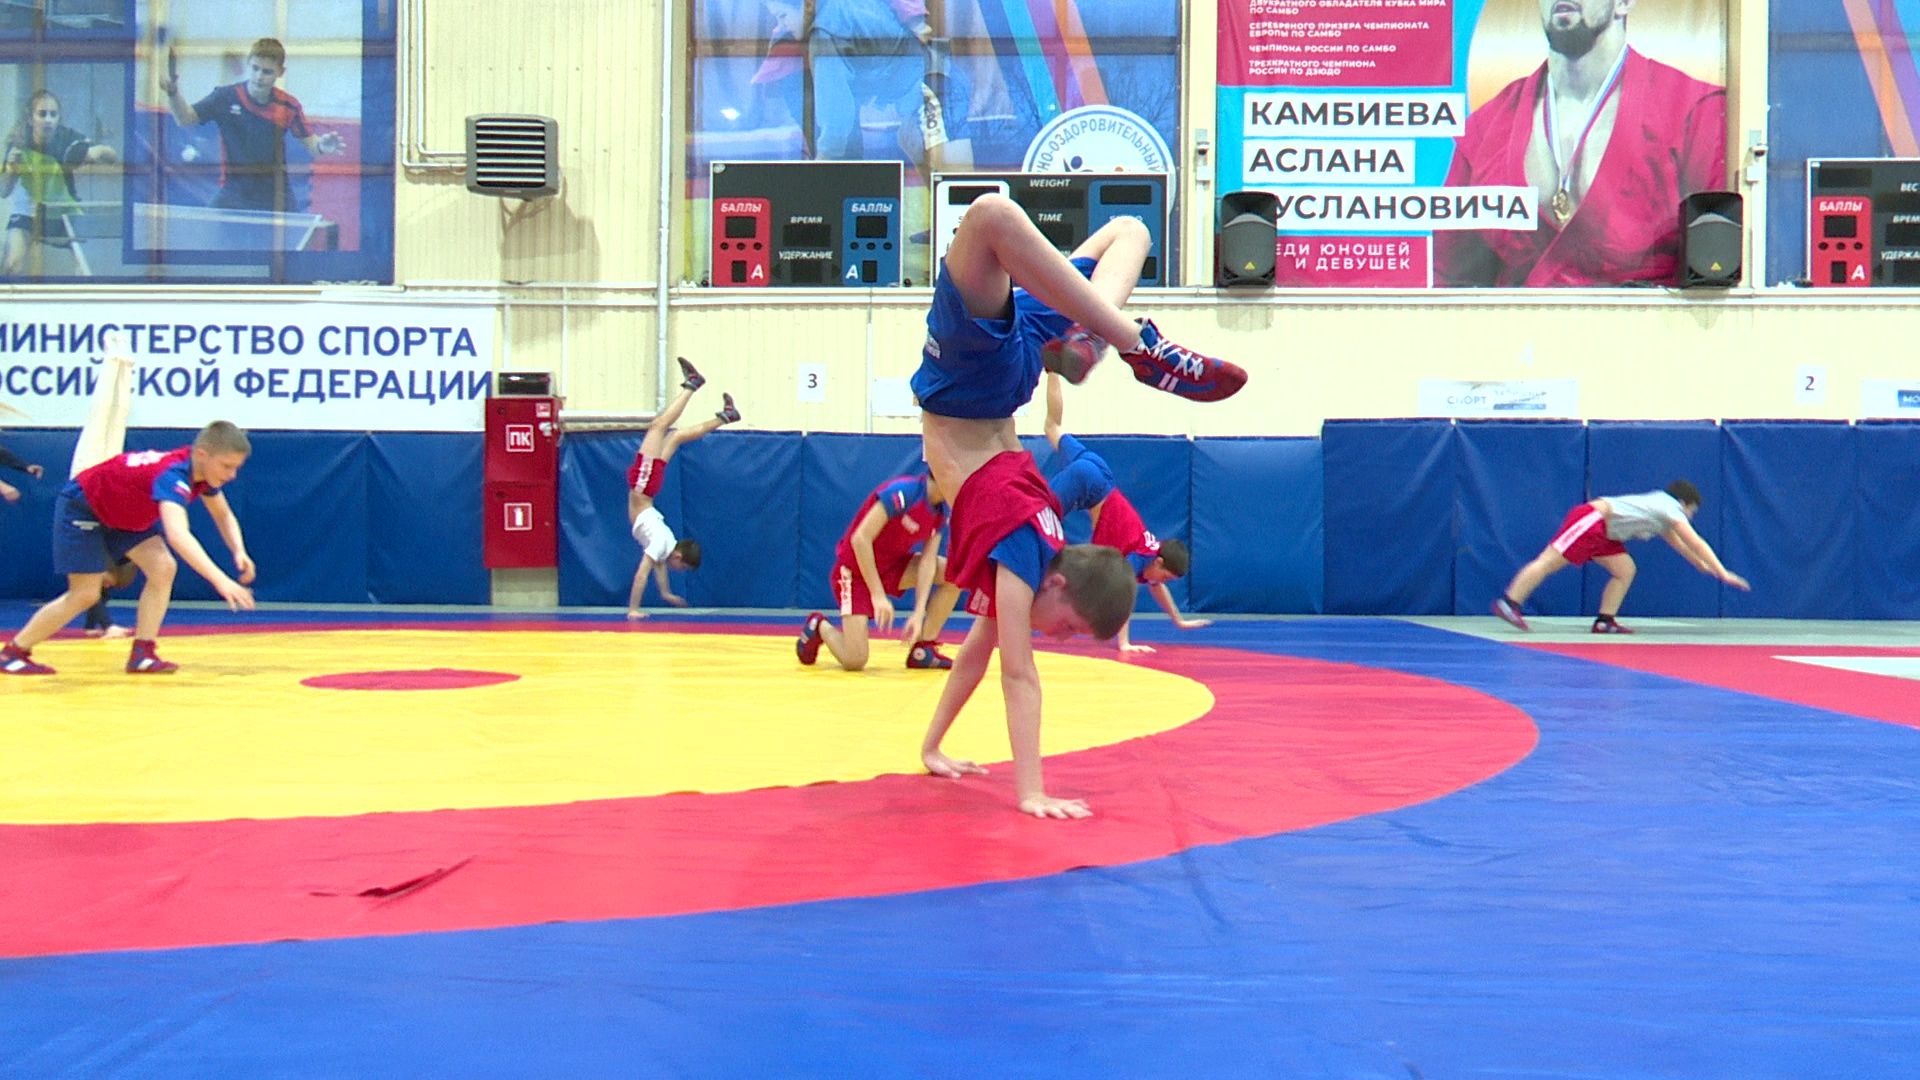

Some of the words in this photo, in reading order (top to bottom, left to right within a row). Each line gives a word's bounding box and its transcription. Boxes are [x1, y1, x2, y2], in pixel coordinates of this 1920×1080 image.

[1266, 7, 1299, 15] САМБО
[1249, 22, 1316, 30] СЕРЕБРЯНОГО
[1318, 22, 1361, 30] ПРИЗЕРА
[1364, 22, 1430, 30] ЧЕМПИОНАТА
[1249, 44, 1302, 52] ЧЕМПИОНА
[1304, 45, 1343, 53] РОССИИ
[1346, 45, 1360, 53] ПО
[1322, 60, 1376, 68] ЧЕМПИОНА
[1249, 67, 1288, 75] РОССИИ
[1305, 68, 1341, 76] ДЗЮДО
[1250, 101, 1457, 126] КАМБИЕВА
[1249, 148, 1405, 173] АСЛАНА
[1029, 178, 1071, 187] WEIGHT
[1900, 182, 1918, 192] ВЕС
[720, 203, 762, 213] БАЛЛЫ
[851, 203, 893, 213] БАЛЛЫ
[1276, 195, 1530, 220] УСЛАНОВИЧА
[1819, 201, 1863, 211] БАЛЛЫ
[790, 216, 823, 224] ВРЕМЯ
[1037, 213, 1063, 222] TIME
[1320, 242, 1410, 256] ЮНОШЕЙ
[778, 251, 833, 260] УДЕРЖАНИЕ
[1295, 258, 1306, 269] И
[1316, 258, 1411, 271] ДЕВУШЕК
[318, 325, 478, 357] СПОРТА
[807, 373, 818, 389] 3
[1805, 375, 1815, 391] 2
[233, 367, 493, 406] ФЕДЕРАЦИИ
[510, 431, 531, 446] ПК
